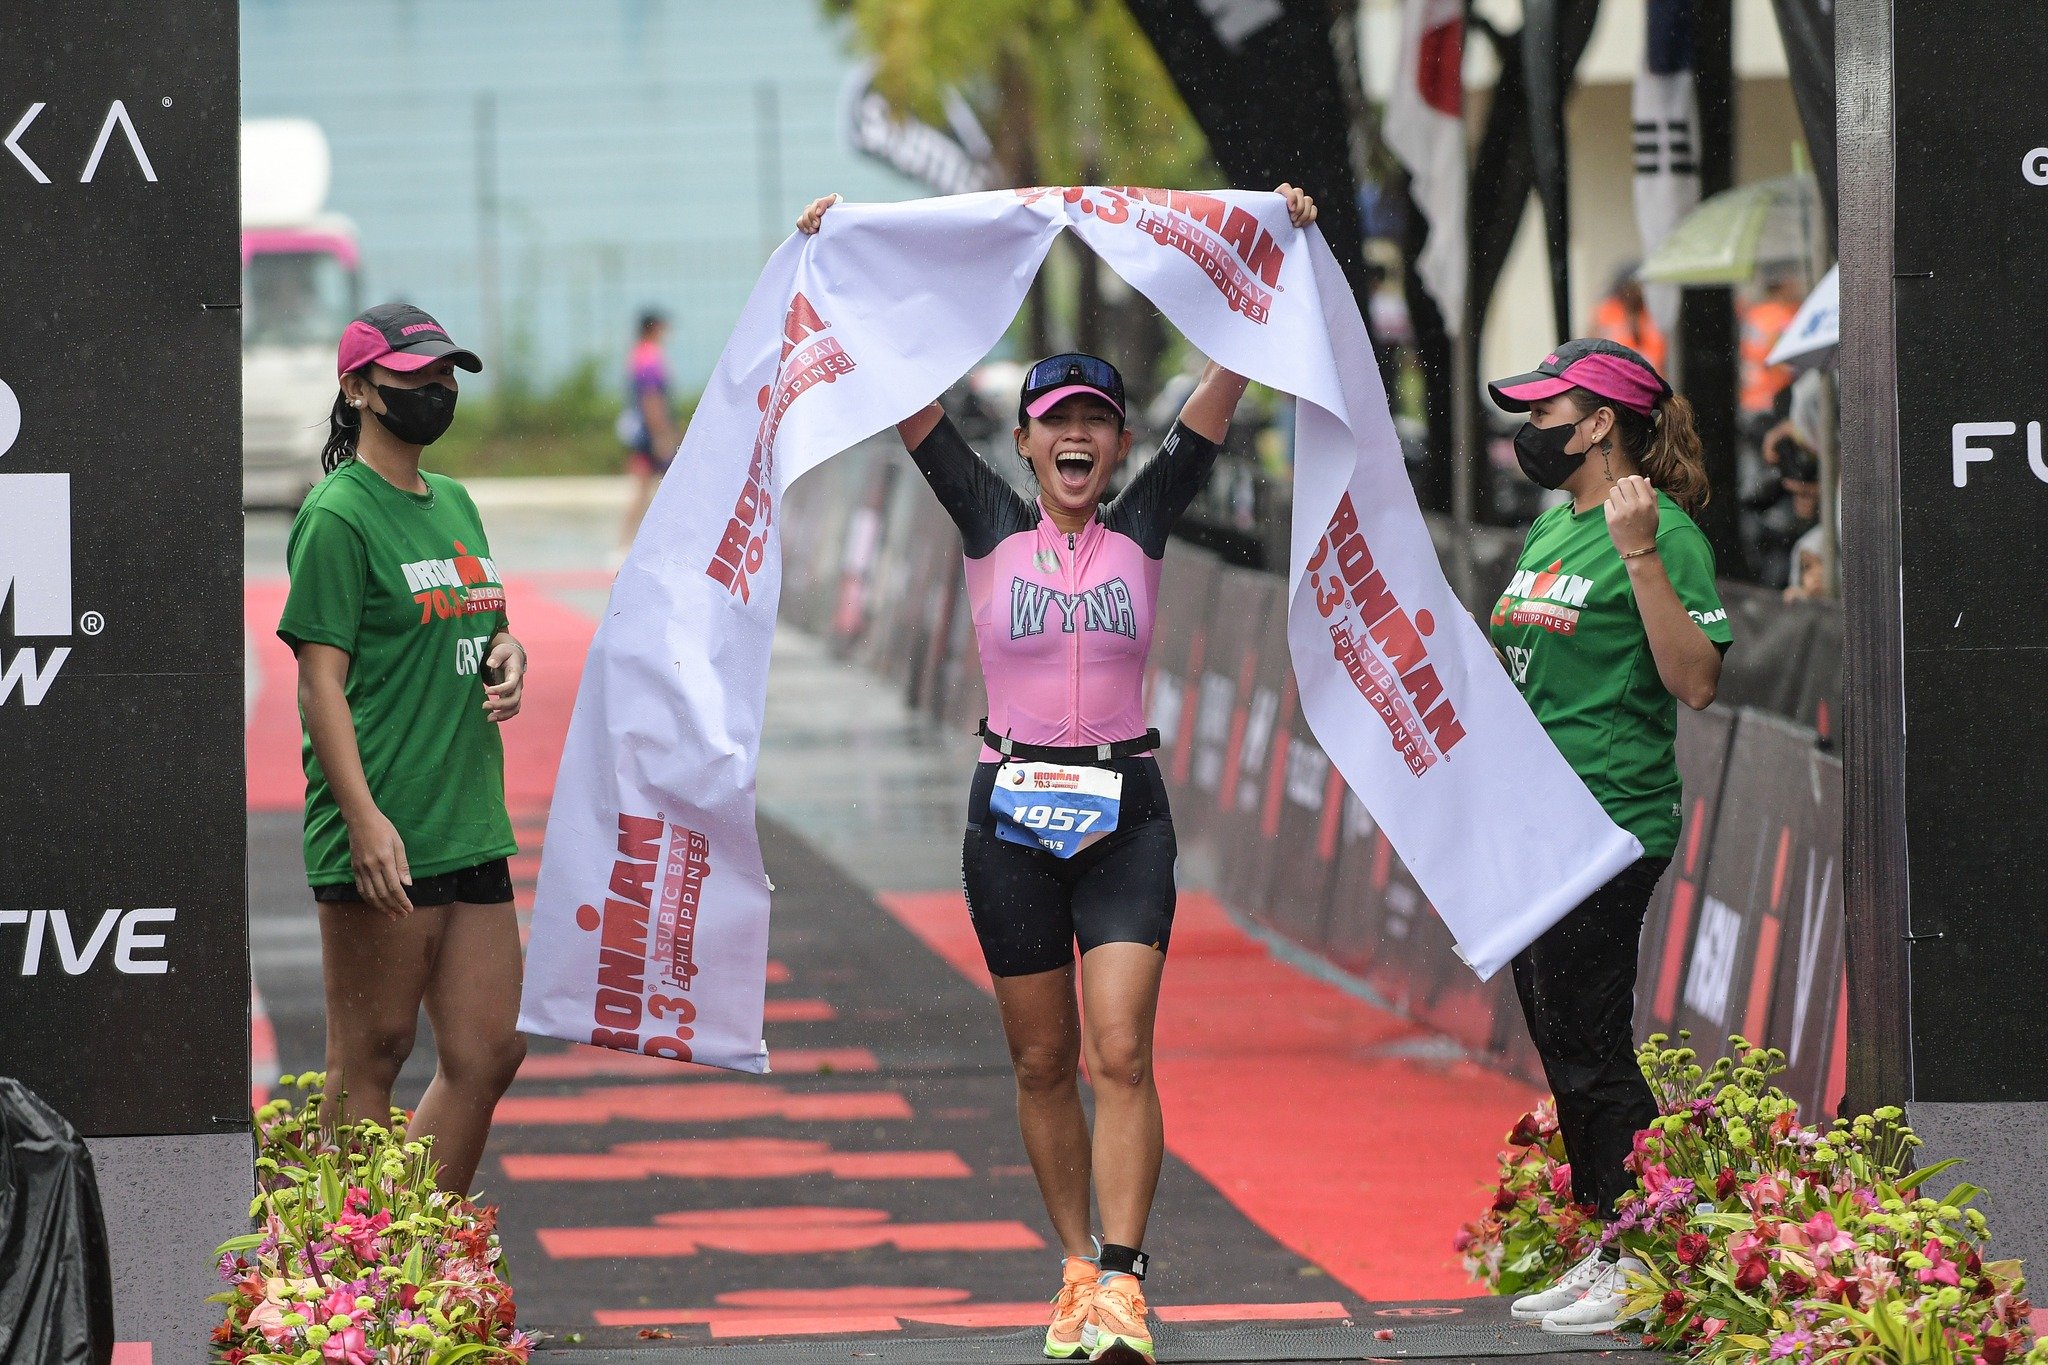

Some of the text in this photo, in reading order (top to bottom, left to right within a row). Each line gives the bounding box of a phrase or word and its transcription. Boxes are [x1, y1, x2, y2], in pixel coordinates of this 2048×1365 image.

[1152, 225, 1261, 317] PHILIPPINES
[1178, 221, 1265, 303] SUBIC BAY
[797, 337, 837, 367] BAY
[730, 488, 772, 606] 70.3
[1010, 576, 1137, 641] WYNR
[1512, 612, 1571, 631] PHILIPPINES
[1548, 605, 1575, 620] BAY
[1336, 637, 1422, 767] PHILIPPINES
[1359, 648, 1435, 758] SUBIC BAY
[1033, 771, 1080, 782] IRONMAN
[1033, 780, 1051, 789] 70.3
[1012, 805, 1102, 833] 1957
[656, 832, 688, 953] SUBIC BAY
[675, 838, 704, 977] PHILIPPINES
